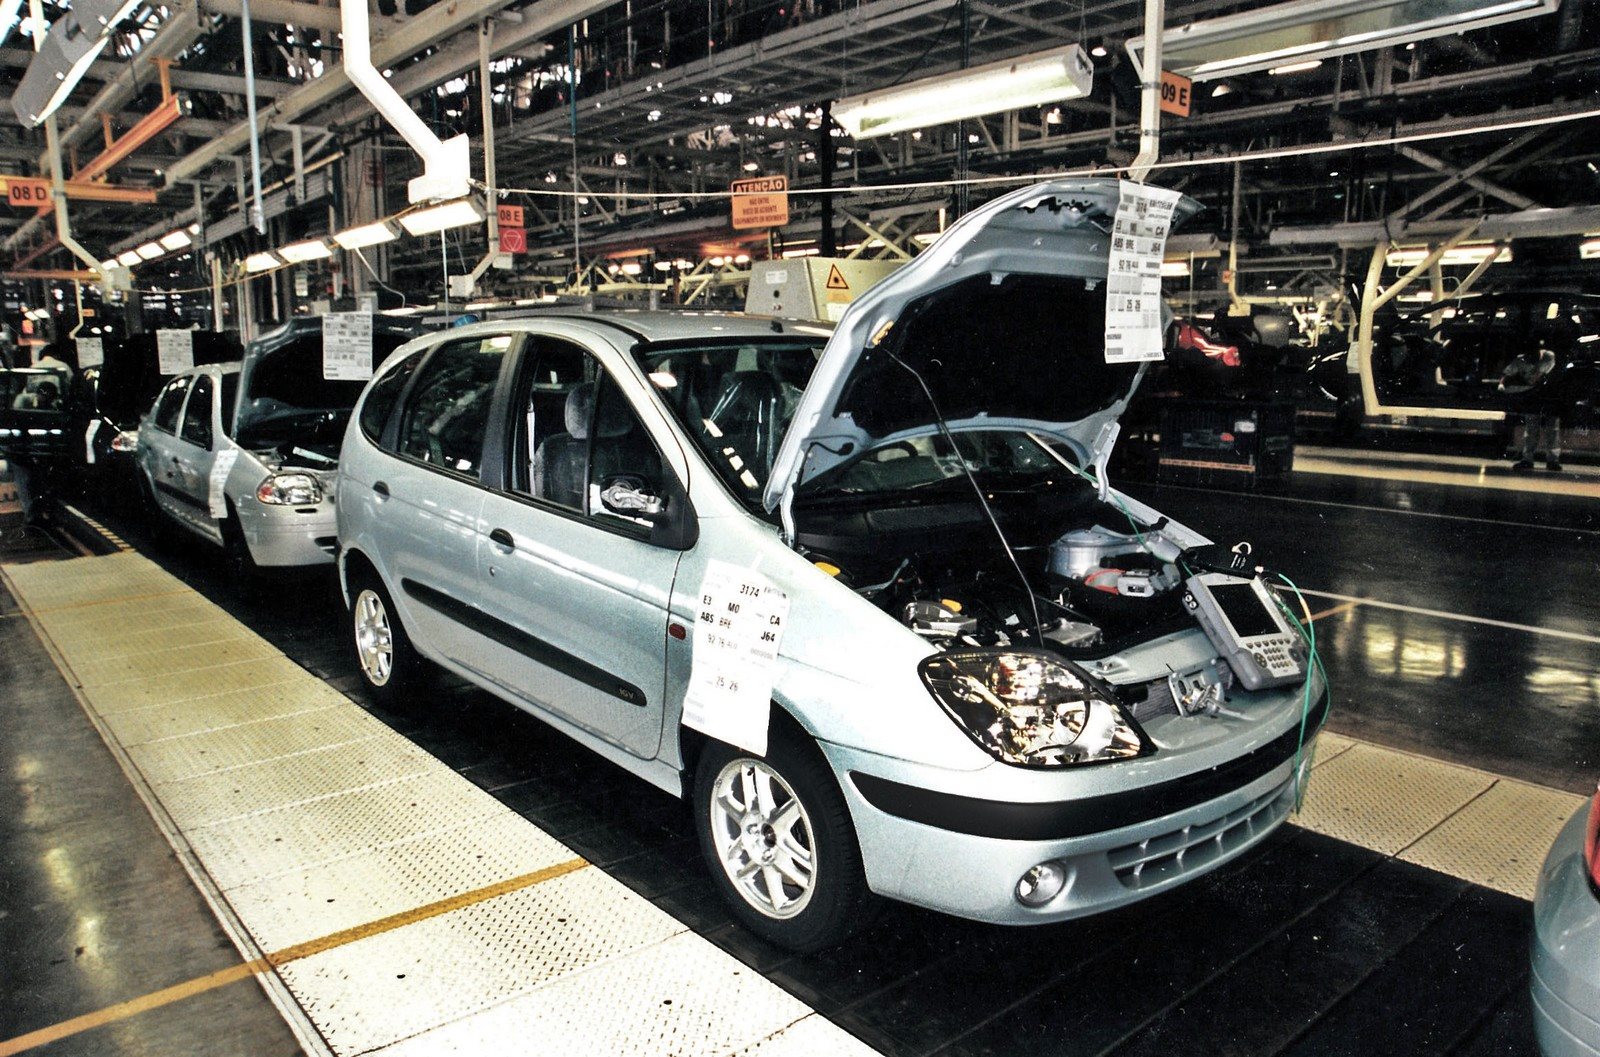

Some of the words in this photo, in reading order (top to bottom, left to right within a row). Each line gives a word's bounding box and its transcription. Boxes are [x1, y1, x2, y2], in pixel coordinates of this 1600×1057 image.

[1161, 82, 1176, 103] 09
[1179, 87, 1187, 107] E
[12, 186, 30, 200] 08
[35, 187, 47, 200] D
[500, 210, 511, 221] 08
[514, 211, 521, 222] E
[740, 584, 760, 597] 3174
[703, 595, 712, 606] E3
[770, 615, 780, 626] CA
[700, 611, 714, 624] ABS
[761, 631, 776, 642] J64
